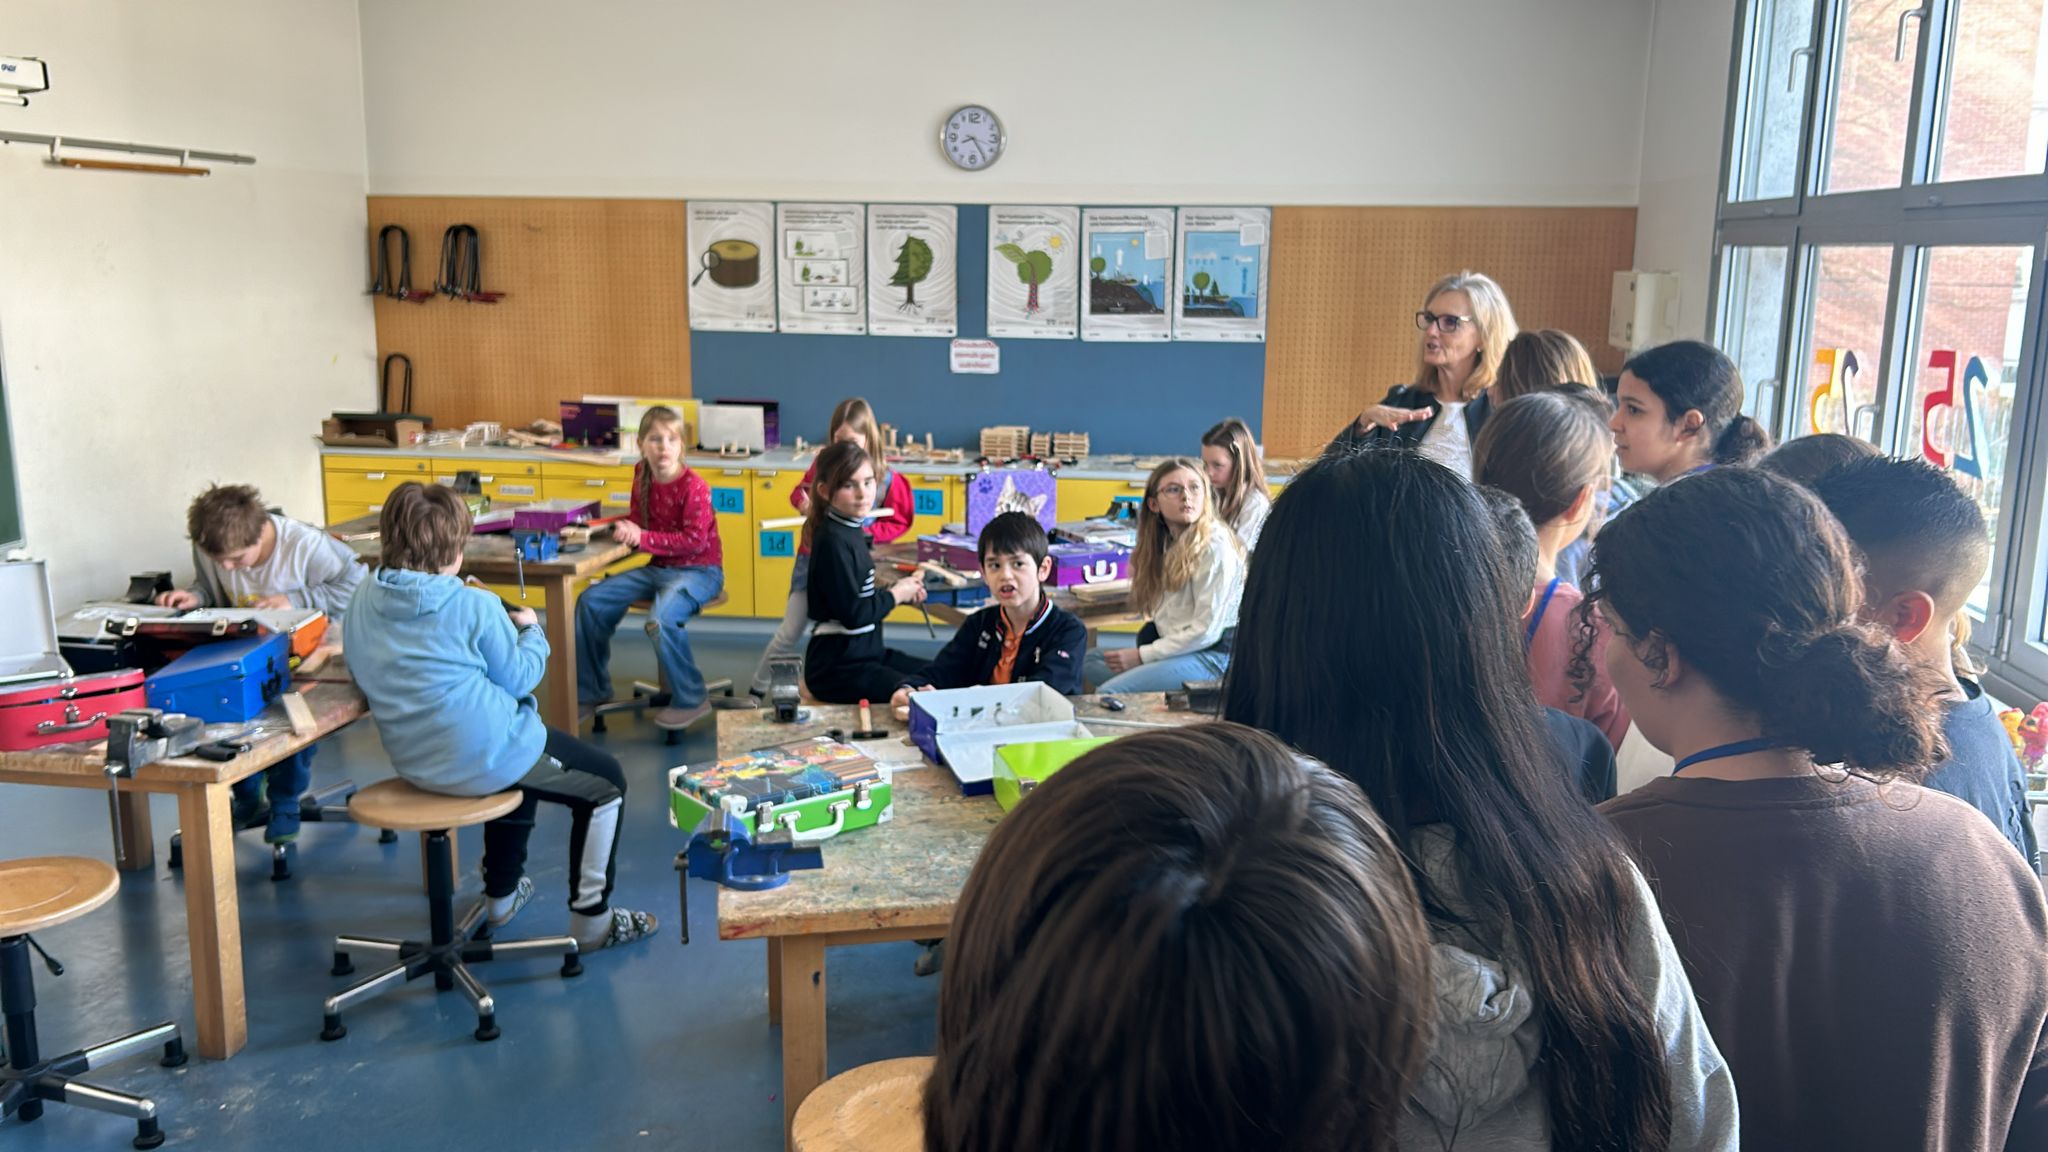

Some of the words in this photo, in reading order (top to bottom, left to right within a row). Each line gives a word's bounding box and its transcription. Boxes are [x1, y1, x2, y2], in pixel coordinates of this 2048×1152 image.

[968, 112, 981, 124] 12
[949, 132, 958, 142] 9
[988, 133, 999, 144] 3
[969, 153, 977, 164] 6
[719, 491, 736, 509] 1a
[918, 494, 936, 511] 1b
[768, 535, 786, 552] 1d
